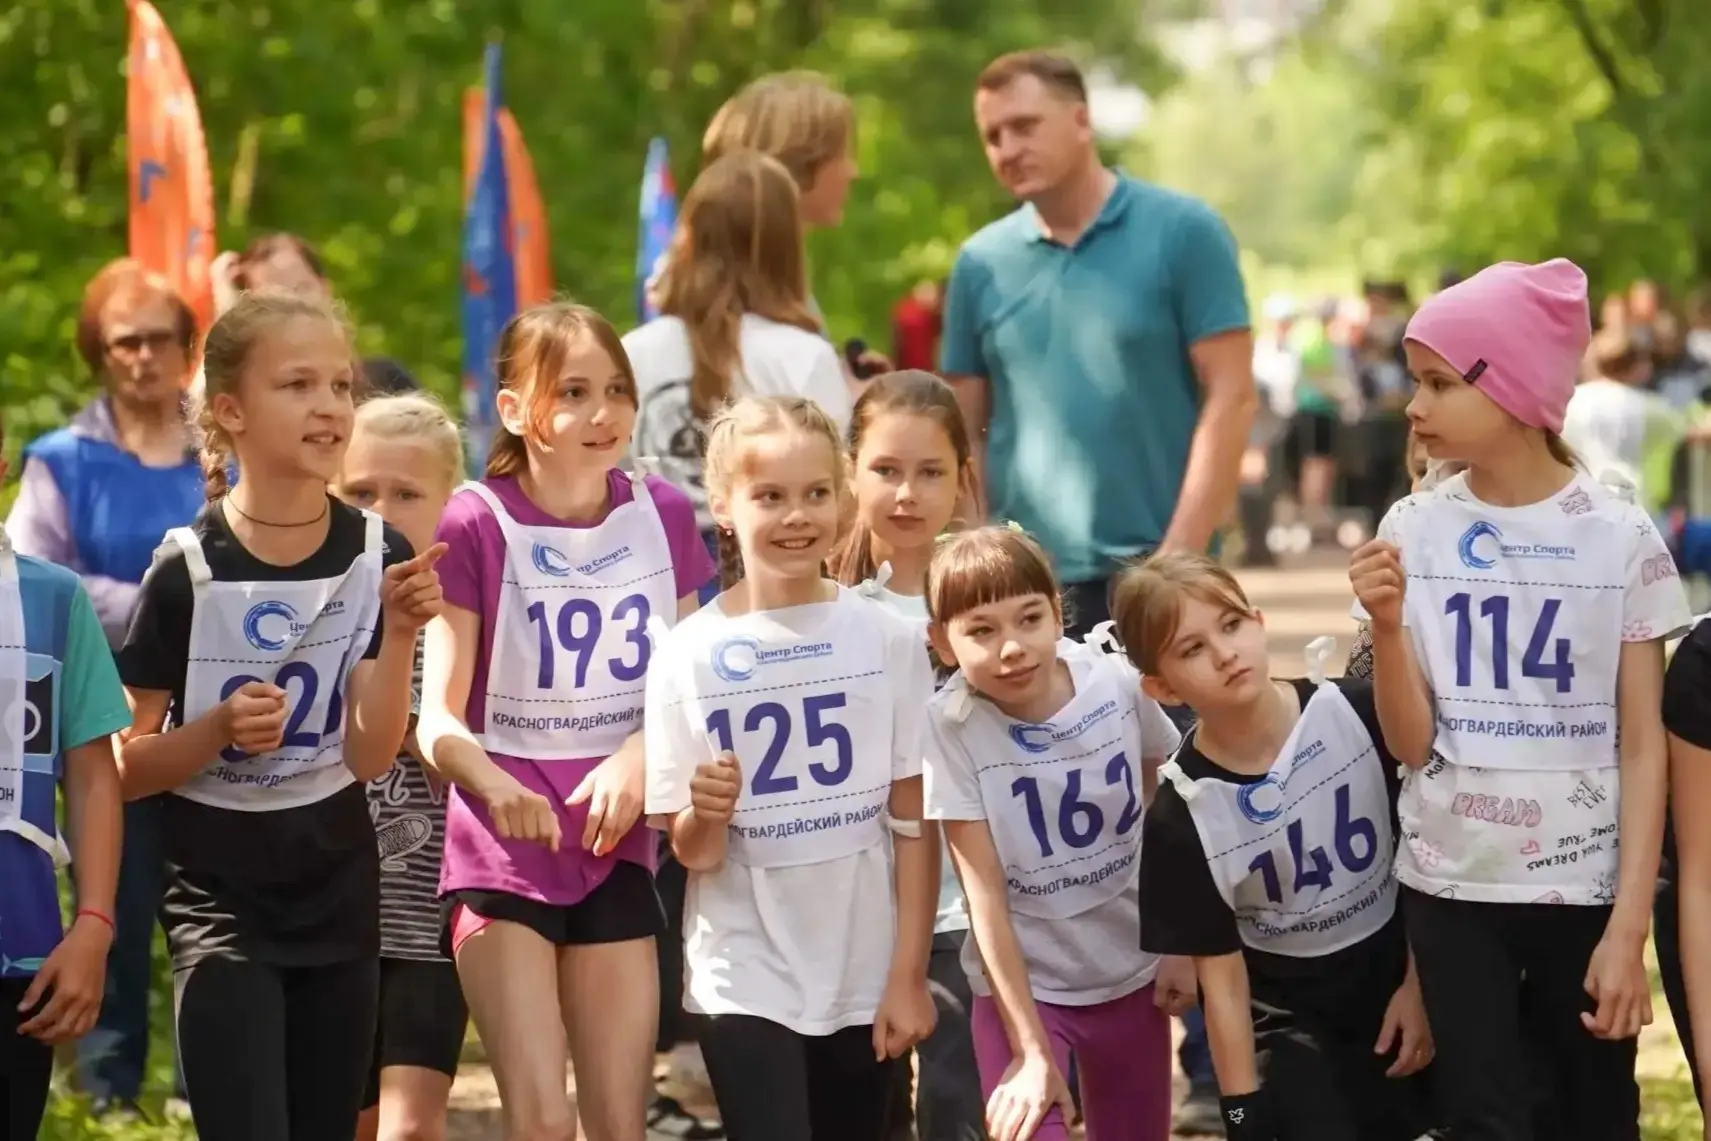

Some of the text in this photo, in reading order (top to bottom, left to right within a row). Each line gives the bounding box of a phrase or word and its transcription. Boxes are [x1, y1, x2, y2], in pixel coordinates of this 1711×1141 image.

[592, 546, 630, 567] Спорта
[1534, 545, 1575, 555] Спорта
[527, 593, 653, 689] 193
[756, 648, 791, 660] Центр
[793, 643, 832, 654] Спорта
[1445, 592, 1575, 693] 114
[492, 708, 635, 731] КРАСНОГВАРДЕЙСКИЙ
[1052, 721, 1083, 740] Центр
[1082, 700, 1117, 724] Спорта
[1571, 720, 1607, 738] РАЙОН
[1011, 751, 1142, 857] 162
[1451, 792, 1542, 828] DREAM
[1590, 823, 1619, 839] OME
[1248, 784, 1377, 904] 146
[1527, 852, 1579, 872] DREAMS
